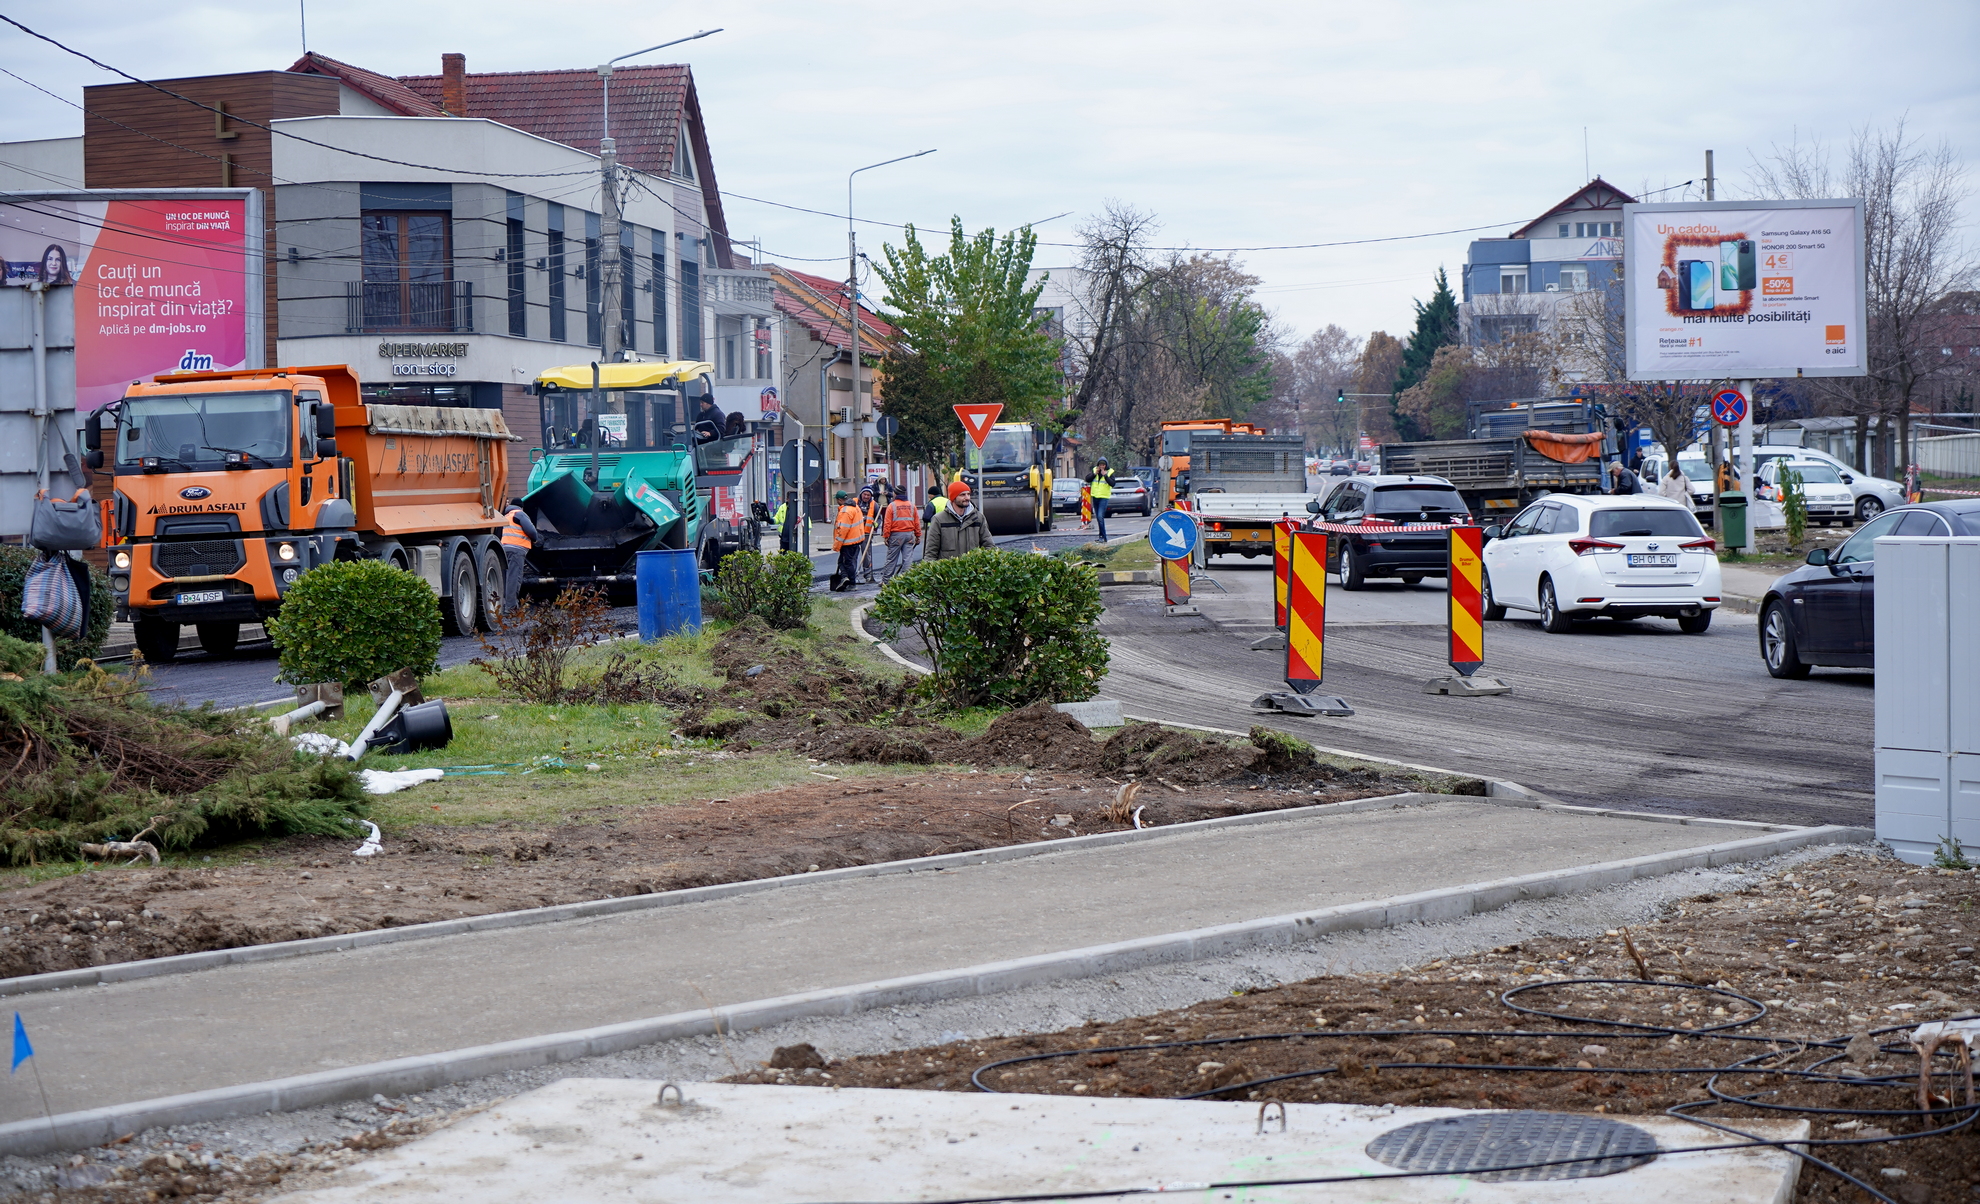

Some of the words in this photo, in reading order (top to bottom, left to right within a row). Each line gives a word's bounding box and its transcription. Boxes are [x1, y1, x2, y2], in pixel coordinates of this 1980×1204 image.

[165, 212, 177, 220] UN
[177, 212, 192, 220] LOC
[192, 212, 202, 220] DE
[203, 210, 230, 220] MUNCĂ
[165, 221, 195, 232] inspirat
[1657, 224, 1675, 235] Un
[1678, 223, 1720, 234] cadou,
[1765, 255, 1776, 269] 4
[98, 264, 136, 282] Cauți
[142, 266, 162, 278] un
[98, 283, 120, 298] loc
[124, 282, 144, 297] de
[149, 280, 201, 297] muncă
[1765, 279, 1790, 288] -50%
[98, 302, 156, 320] inspirat
[160, 300, 184, 316] din
[189, 299, 233, 319] viață?
[1683, 312, 1705, 324] mai
[1710, 311, 1744, 323] multe
[1748, 310, 1811, 324] posibilități
[99, 324, 130, 336] Aplică
[133, 326, 146, 336] pe
[149, 323, 206, 336] dm-jobs.ro
[1689, 337, 1702, 347] #1
[378, 342, 470, 358] SUPERMARKET
[180, 351, 212, 370] dm
[416, 454, 444, 472] DRUM
[444, 453, 475, 472] ASFALT
[186, 488, 204, 497] Ford
[169, 504, 203, 513] DRUM
[206, 502, 247, 512] ASFALT
[203, 593, 220, 601] DSF
